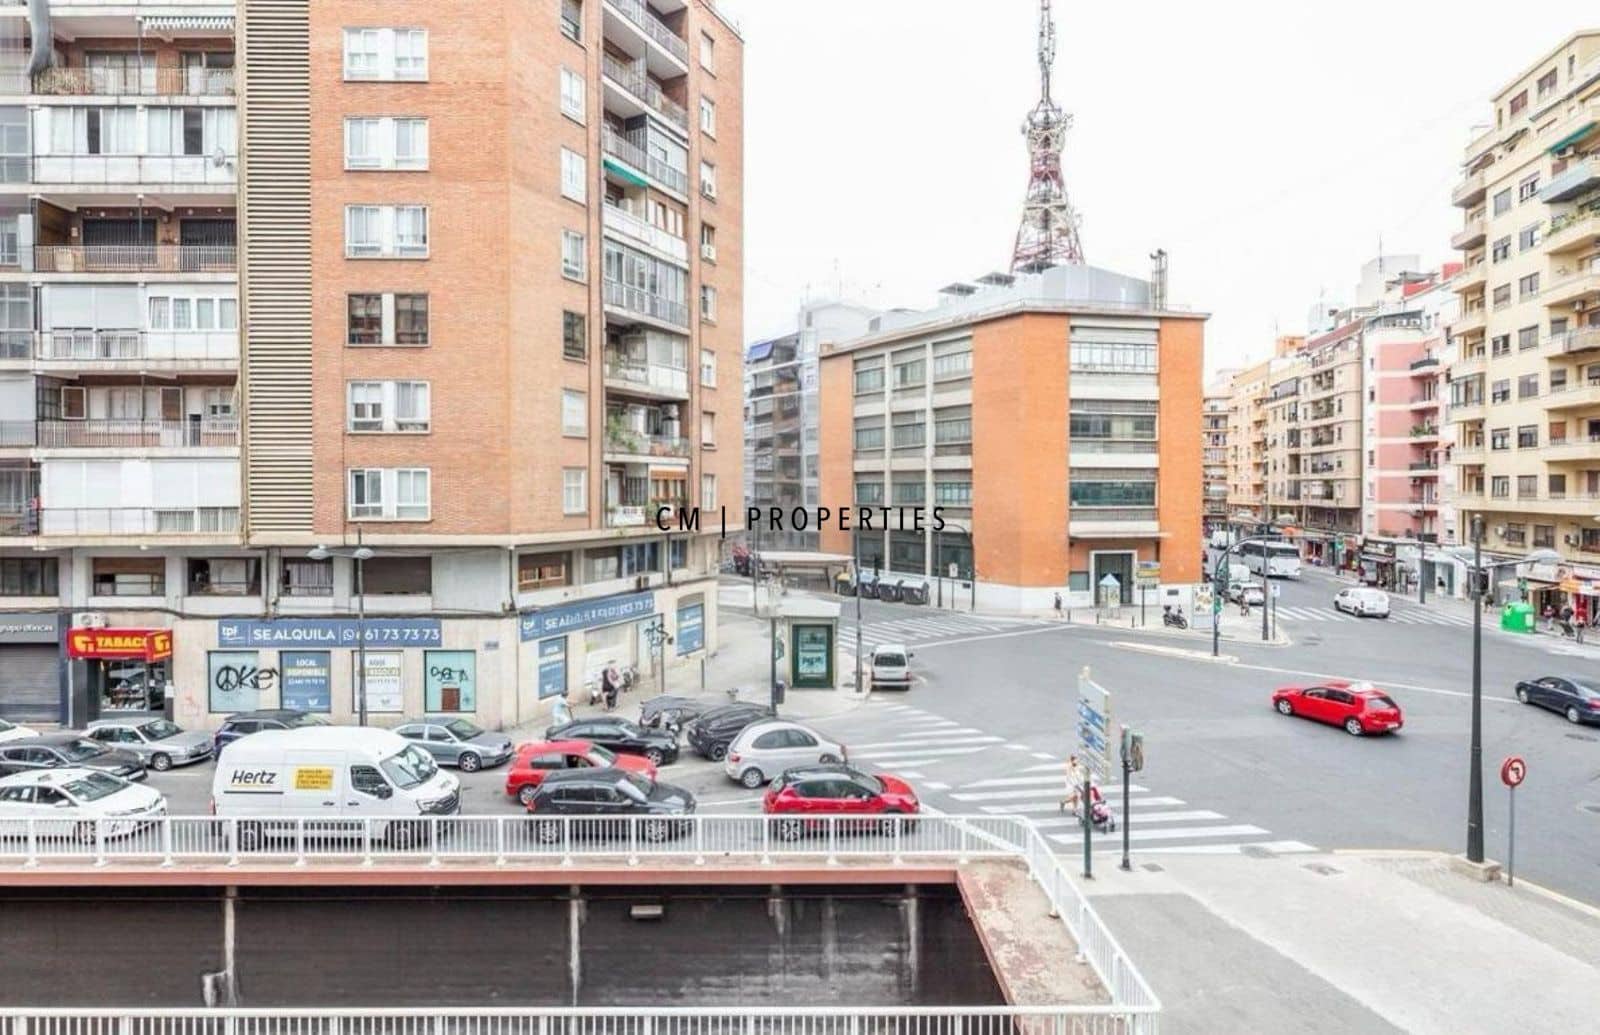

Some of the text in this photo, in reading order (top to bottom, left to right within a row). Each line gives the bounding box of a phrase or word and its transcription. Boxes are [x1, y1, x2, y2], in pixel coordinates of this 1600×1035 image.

[253, 628, 272, 640] SE
[273, 628, 336, 641] ALQUILA
[382, 628, 399, 640] 73
[402, 628, 419, 640] 73
[422, 628, 440, 640] 73
[231, 769, 277, 784] Hertz
